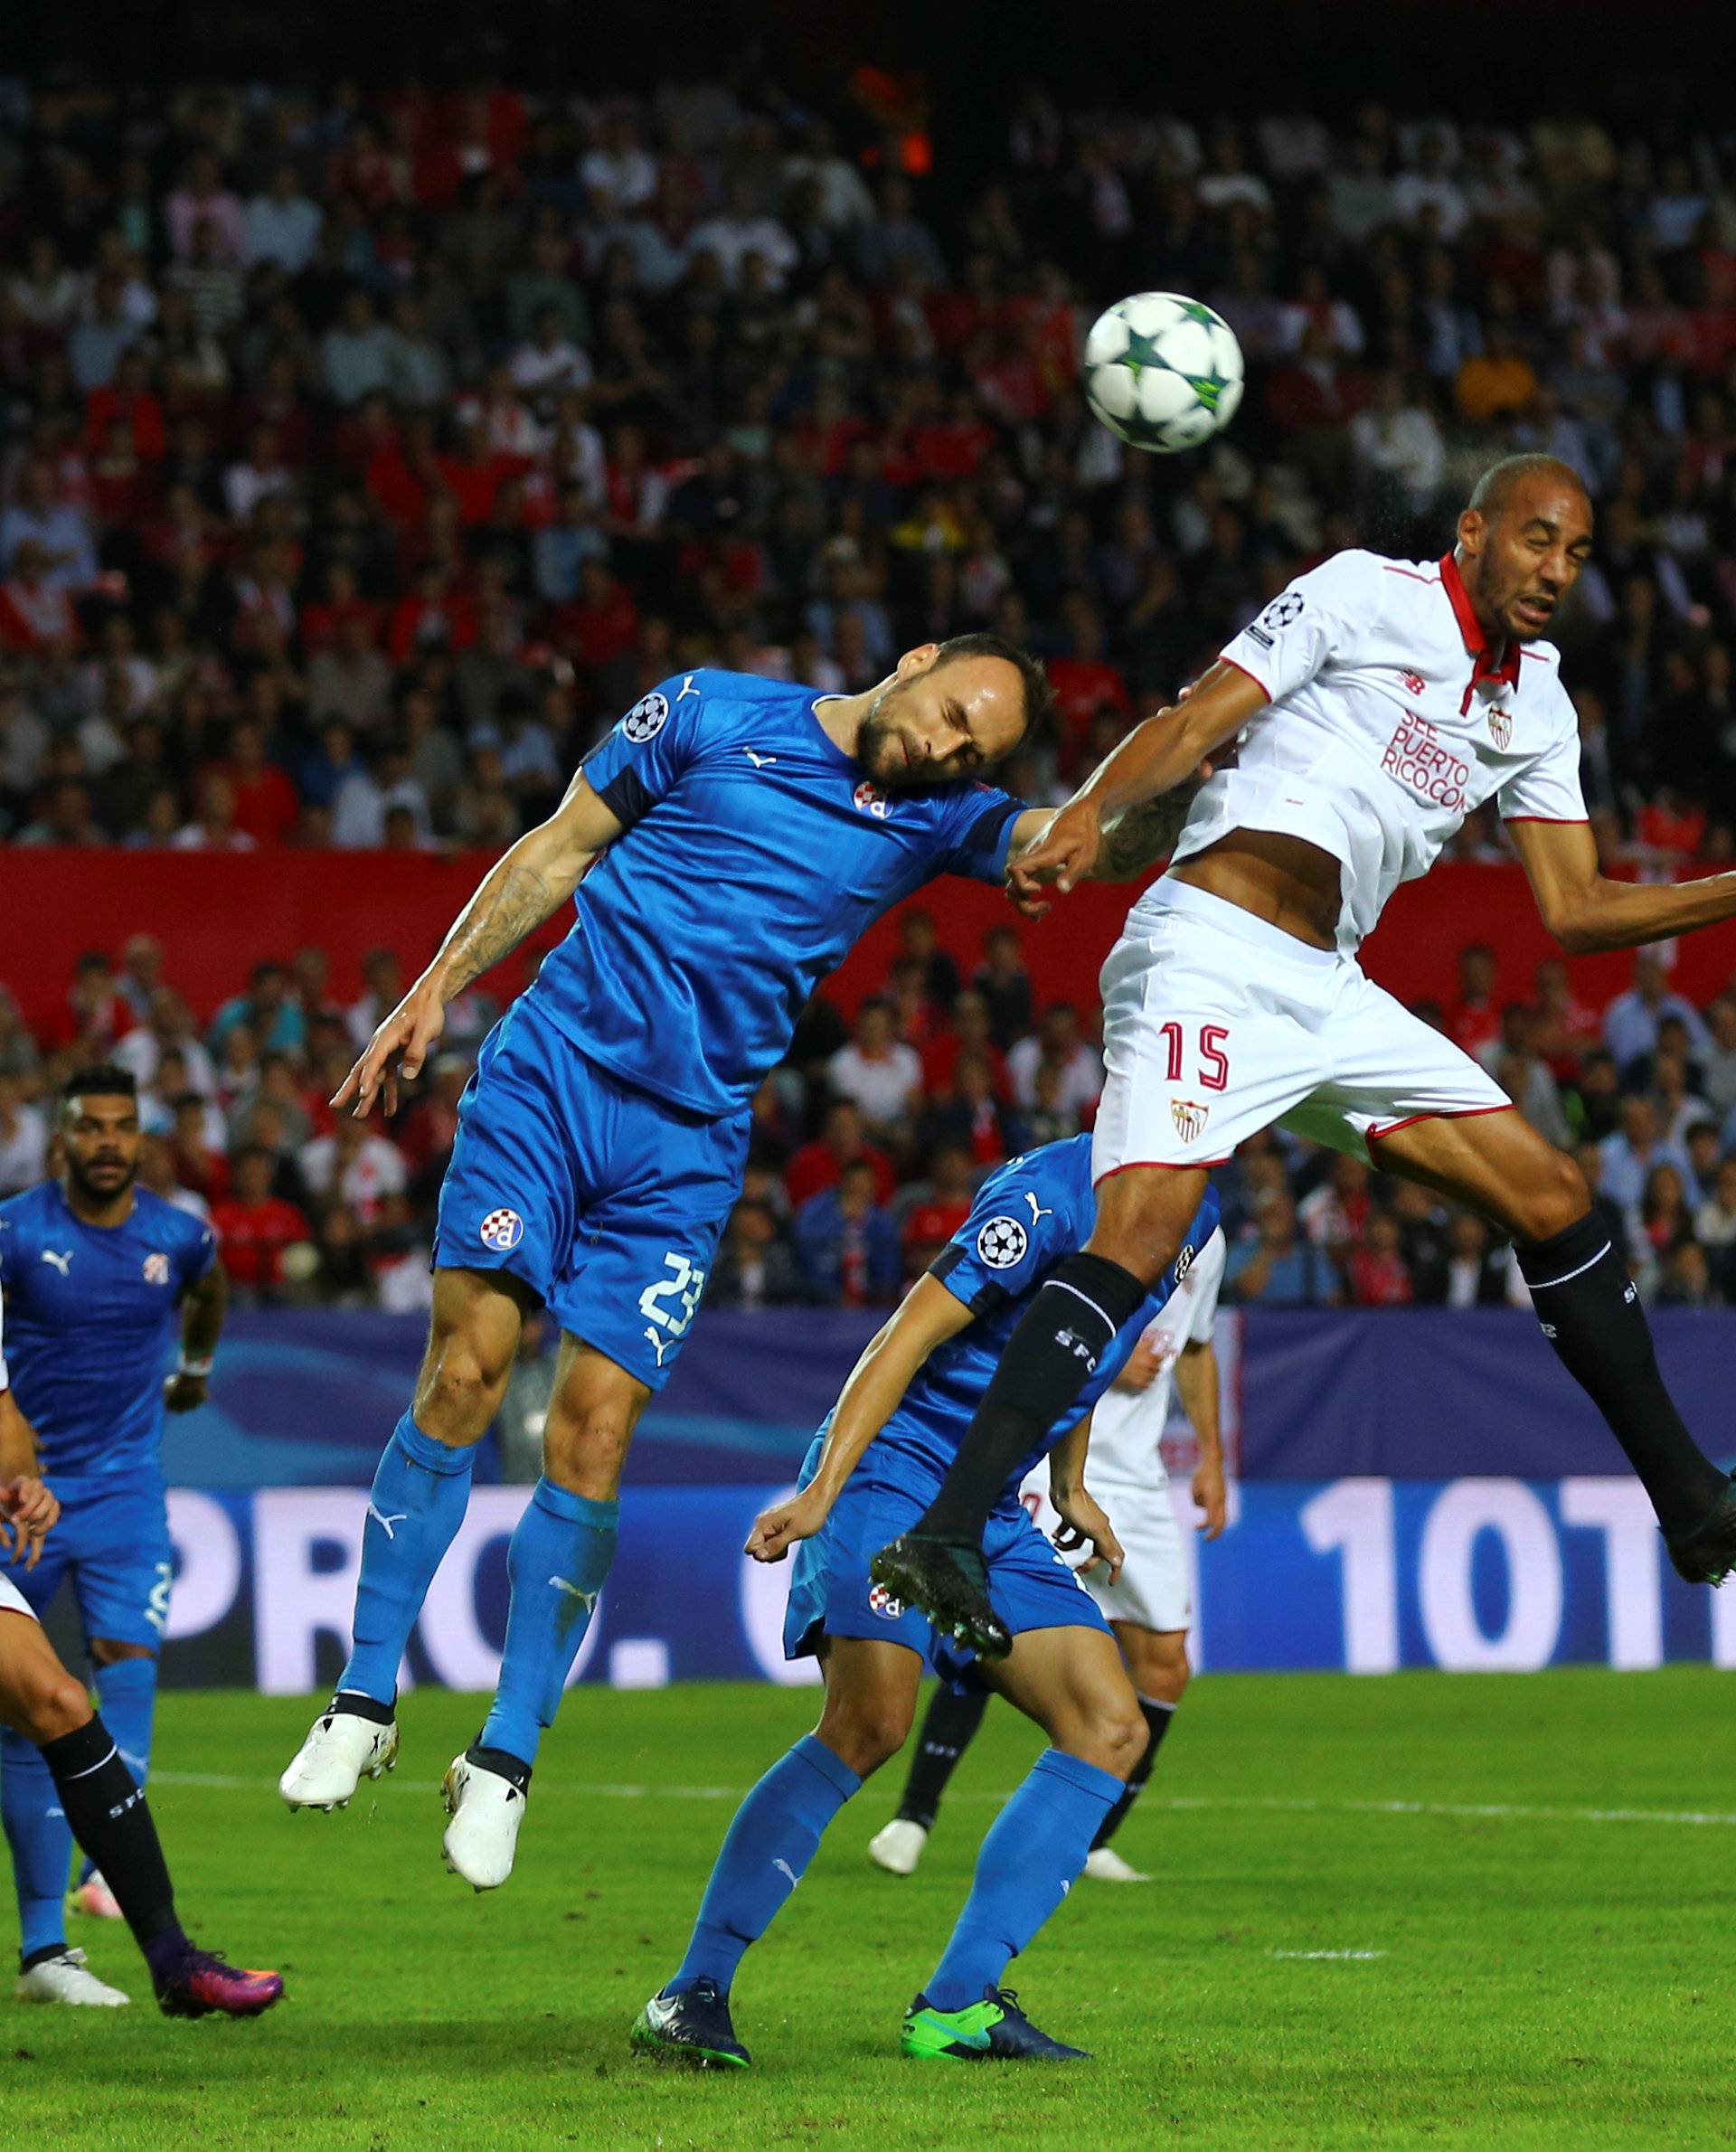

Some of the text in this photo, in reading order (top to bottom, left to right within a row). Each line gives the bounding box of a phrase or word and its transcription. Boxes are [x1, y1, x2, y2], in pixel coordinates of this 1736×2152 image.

[1391, 726, 1469, 786] PUERTO
[1401, 708, 1438, 741] SEE
[1159, 1022, 1230, 1091] 15
[638, 1251, 704, 1336] 23
[1300, 1476, 1736, 1675] 10T
